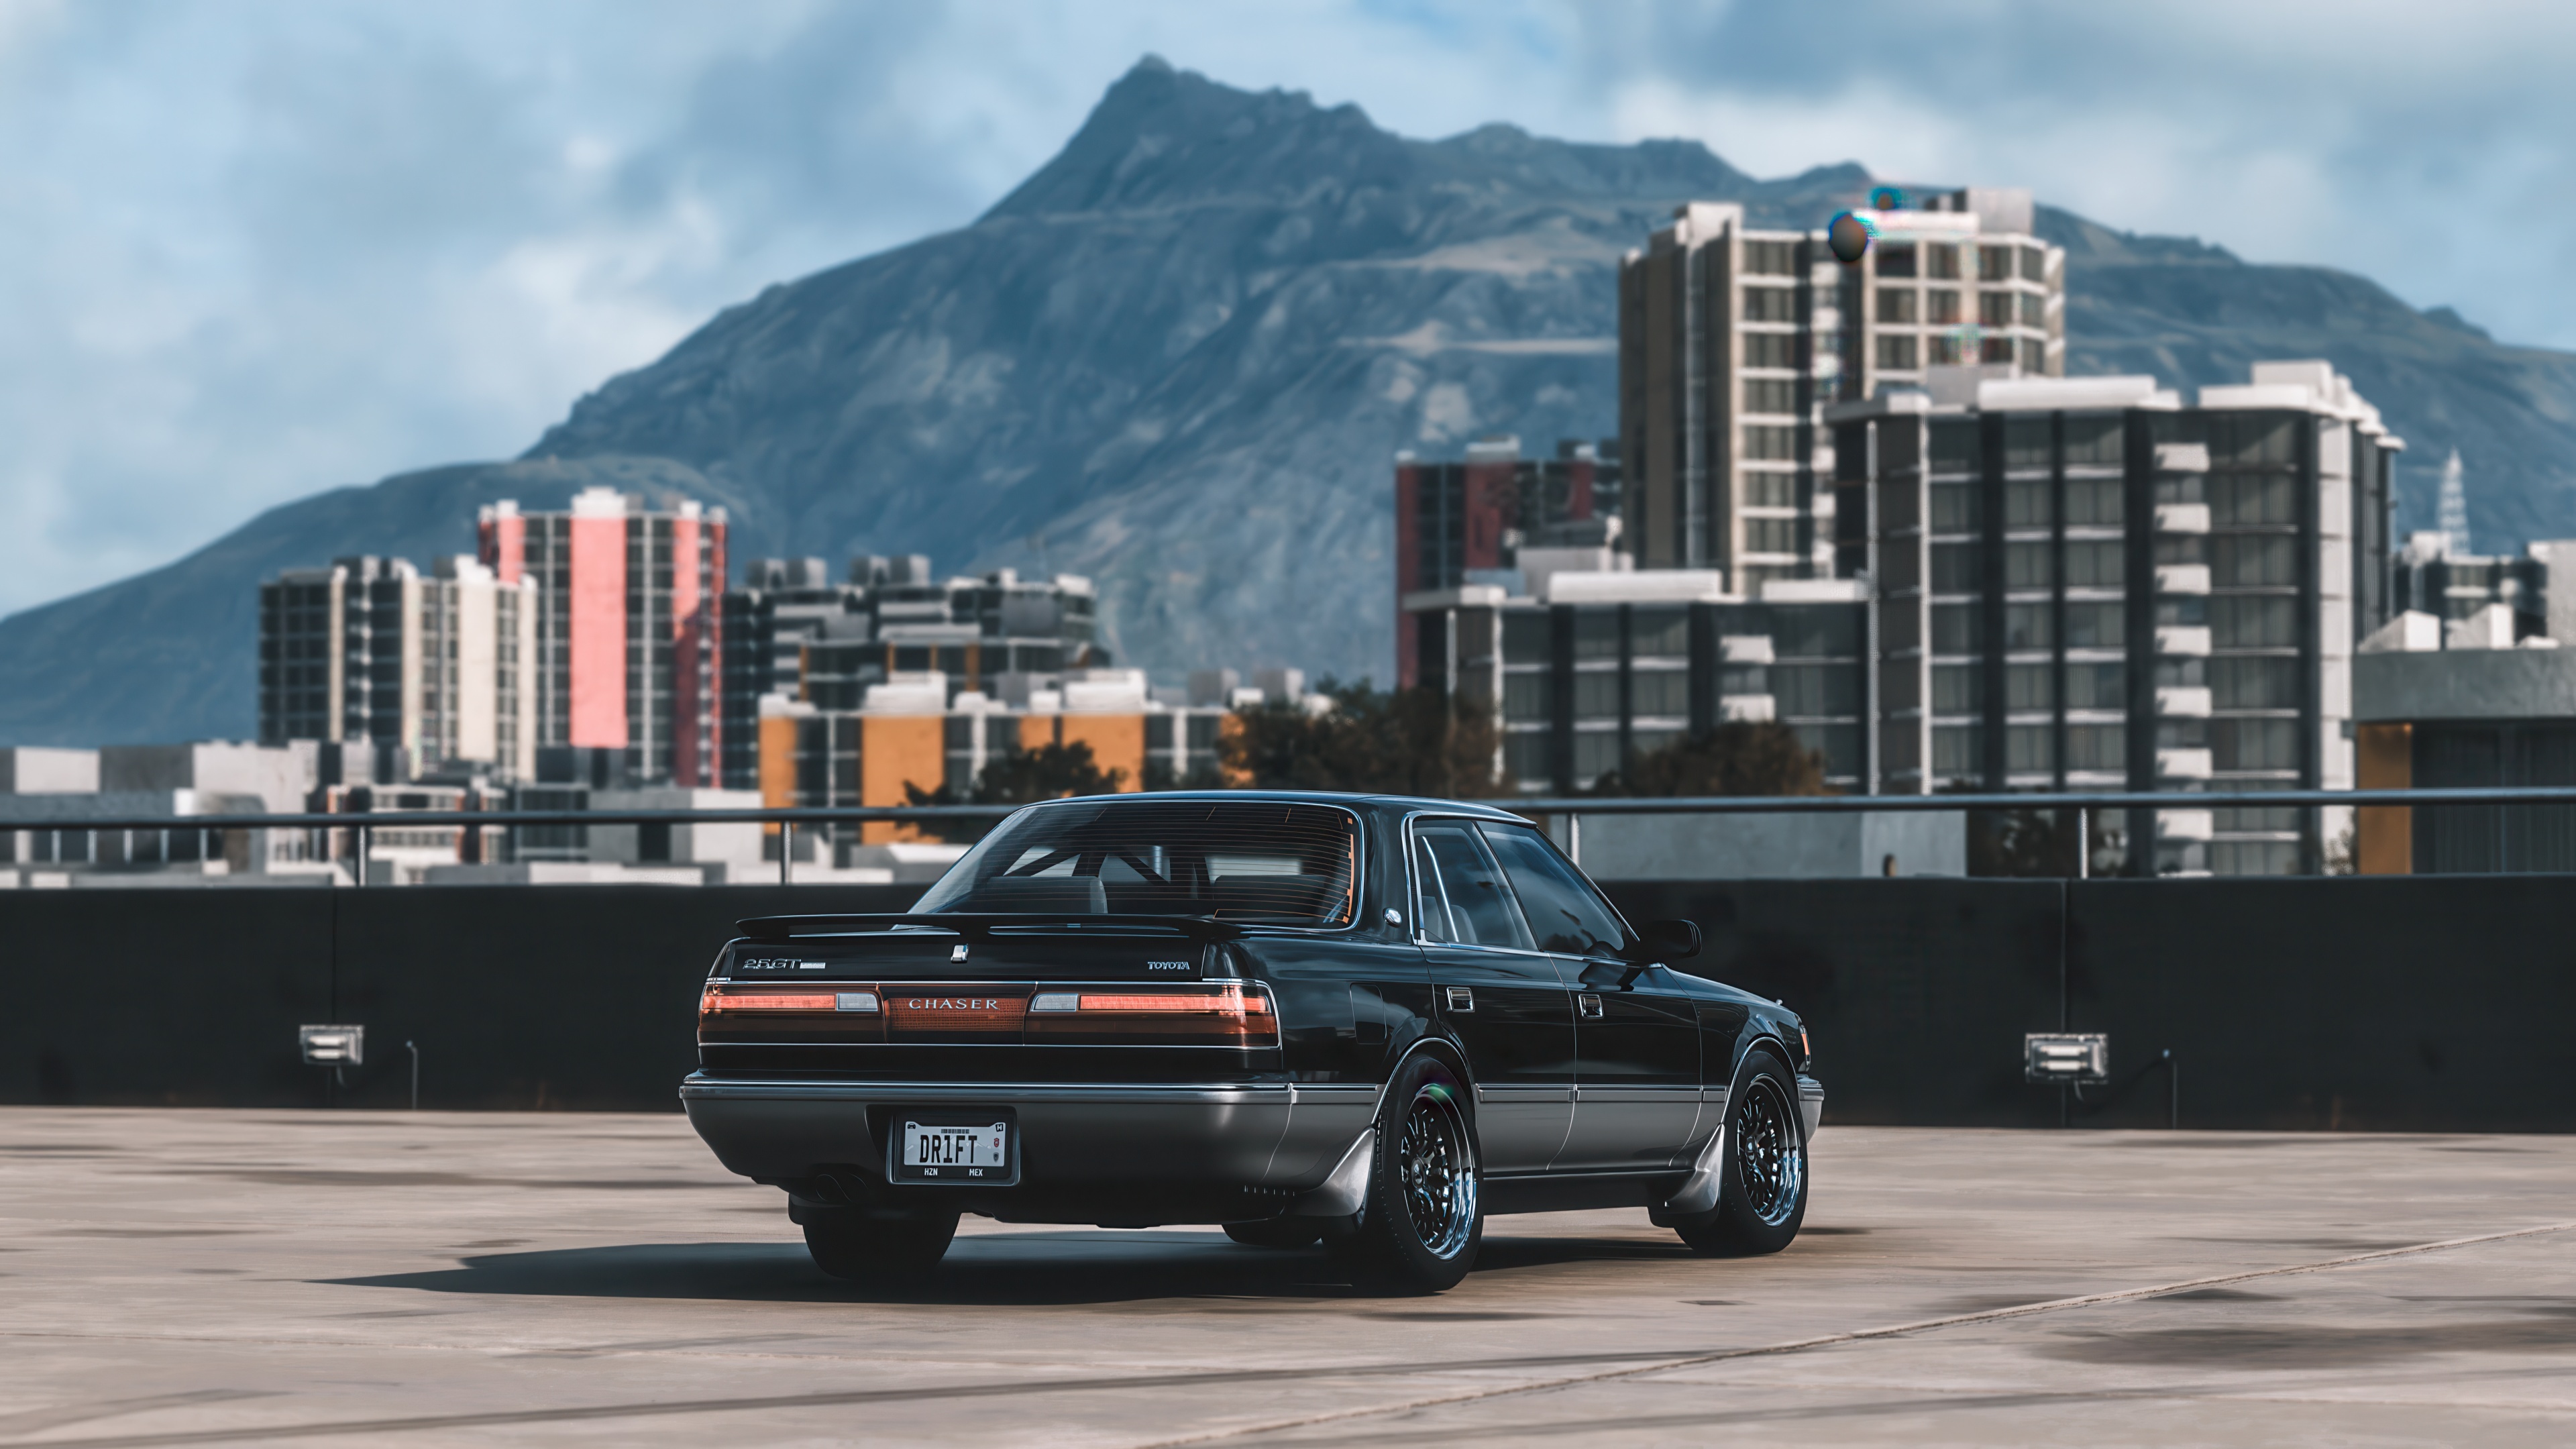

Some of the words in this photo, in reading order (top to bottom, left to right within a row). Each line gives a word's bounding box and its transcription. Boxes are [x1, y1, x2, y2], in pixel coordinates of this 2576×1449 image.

[1148, 961, 1190, 970] TOYOTA
[909, 999, 1000, 1010] CHASER
[920, 1134, 977, 1163] DR1FT
[924, 1168, 938, 1176] HZN
[969, 1169, 983, 1177] MEX
